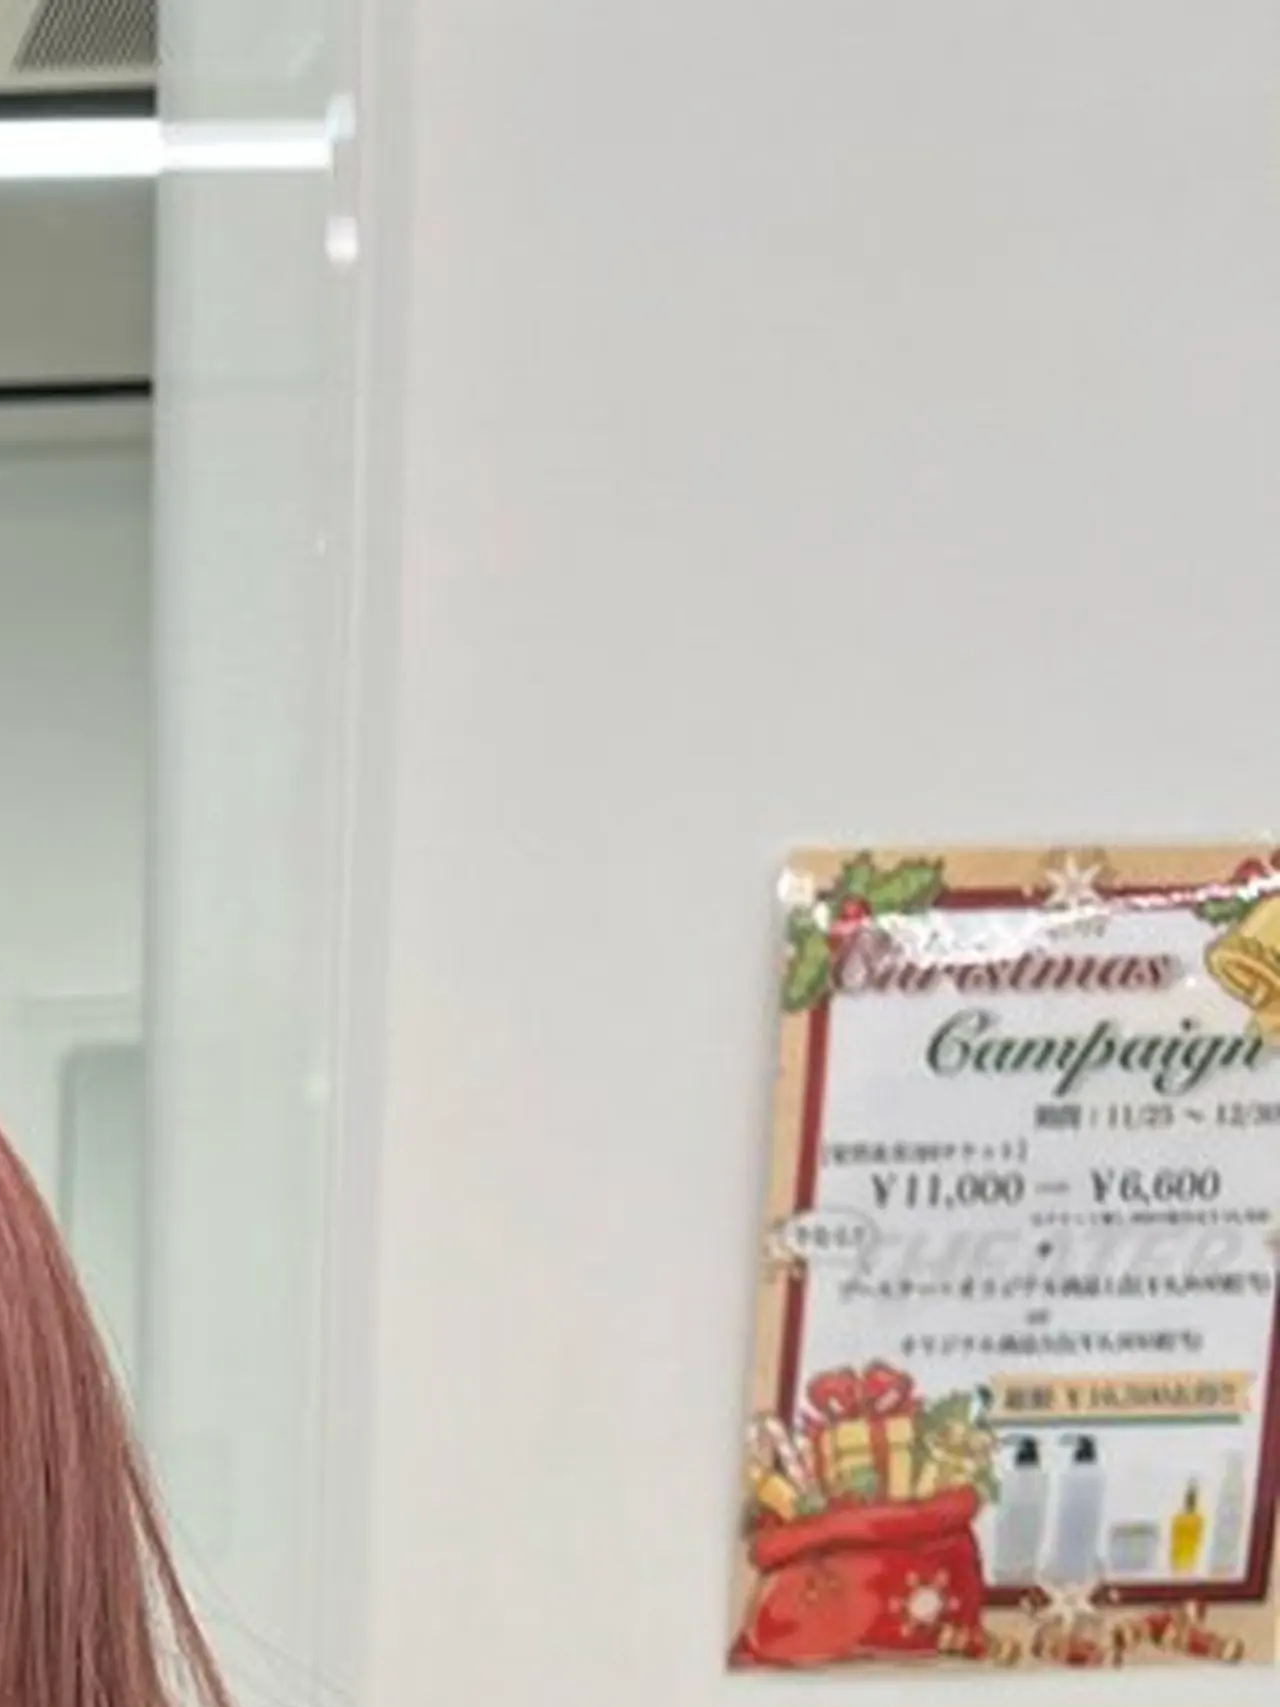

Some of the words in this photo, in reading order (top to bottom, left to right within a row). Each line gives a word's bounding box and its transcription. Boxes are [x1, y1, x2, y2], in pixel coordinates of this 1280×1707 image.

[925, 1008, 1265, 1097] Campaign
[870, 1171, 1026, 1211] ¥11,000
[1090, 1165, 1222, 1207] ¥6,600
